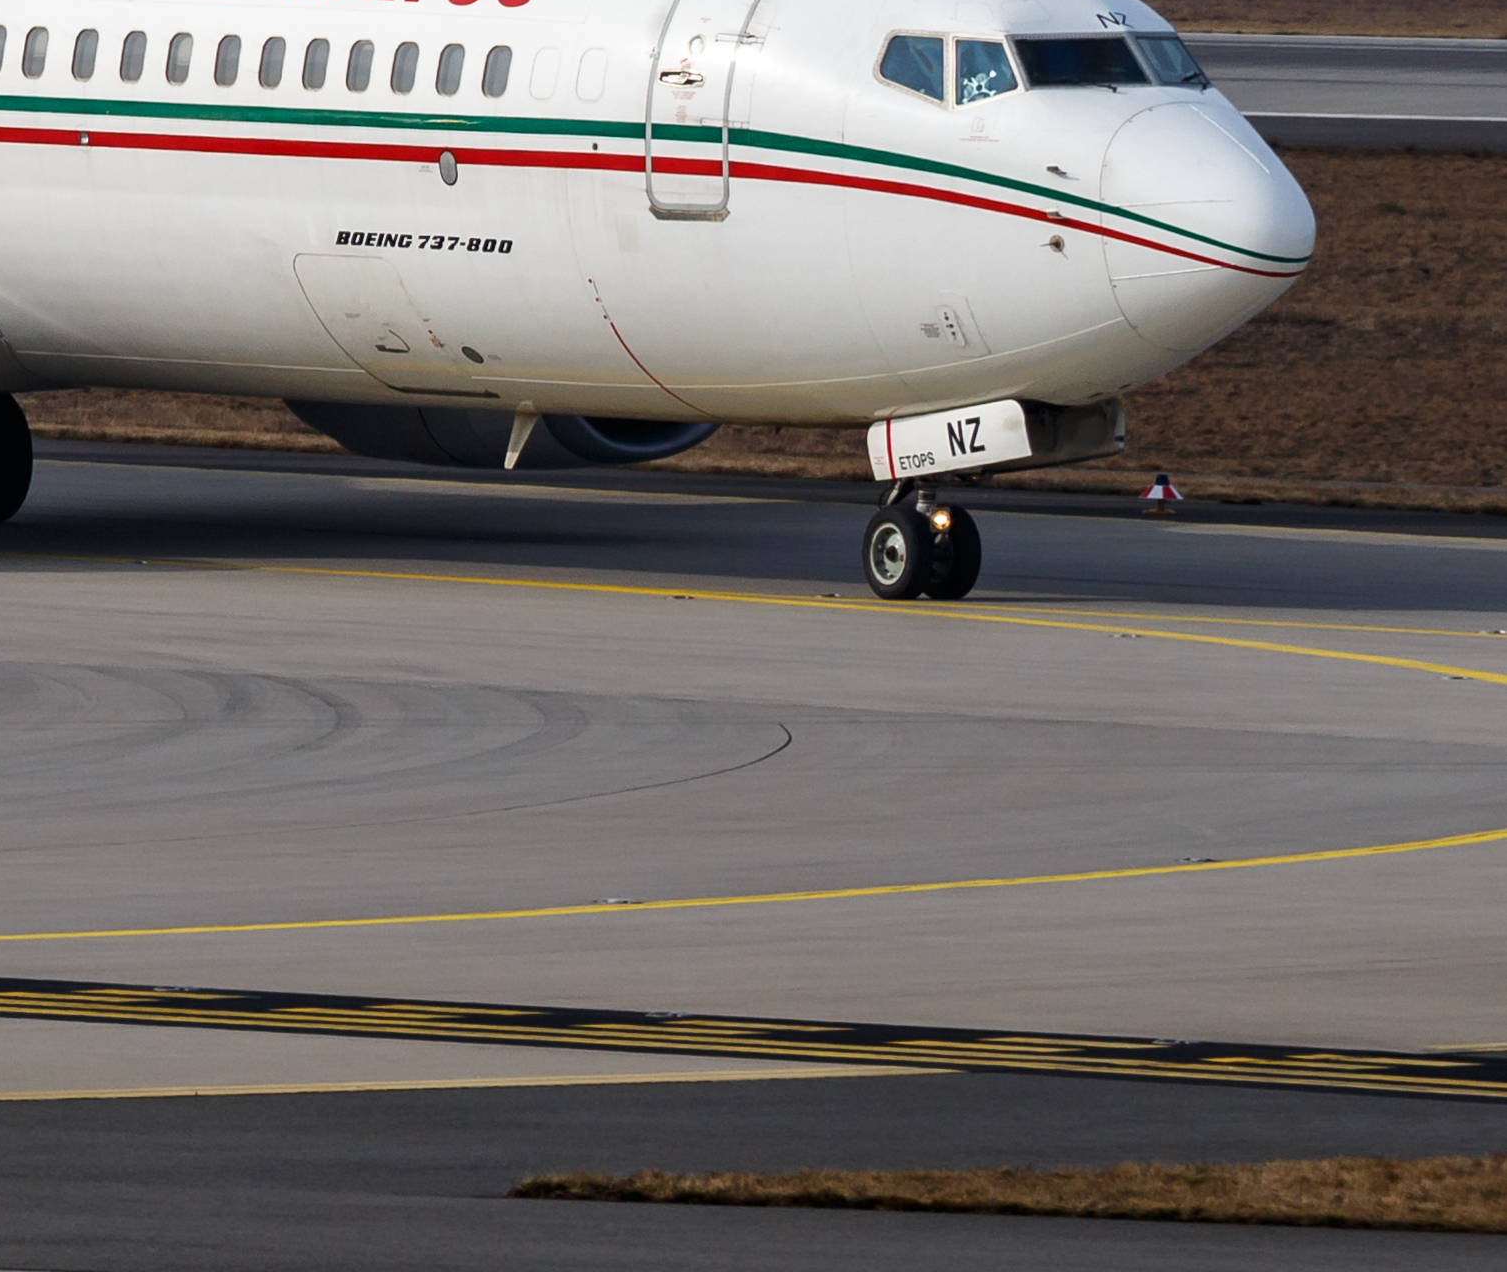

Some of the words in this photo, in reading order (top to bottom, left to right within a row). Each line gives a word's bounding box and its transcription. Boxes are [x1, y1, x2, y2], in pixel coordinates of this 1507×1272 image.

[1095, 11, 1134, 29] NZ
[335, 231, 413, 248] BOEING
[417, 235, 513, 253] 737-800
[946, 417, 985, 456] NZ
[898, 452, 935, 470] ETOPS
